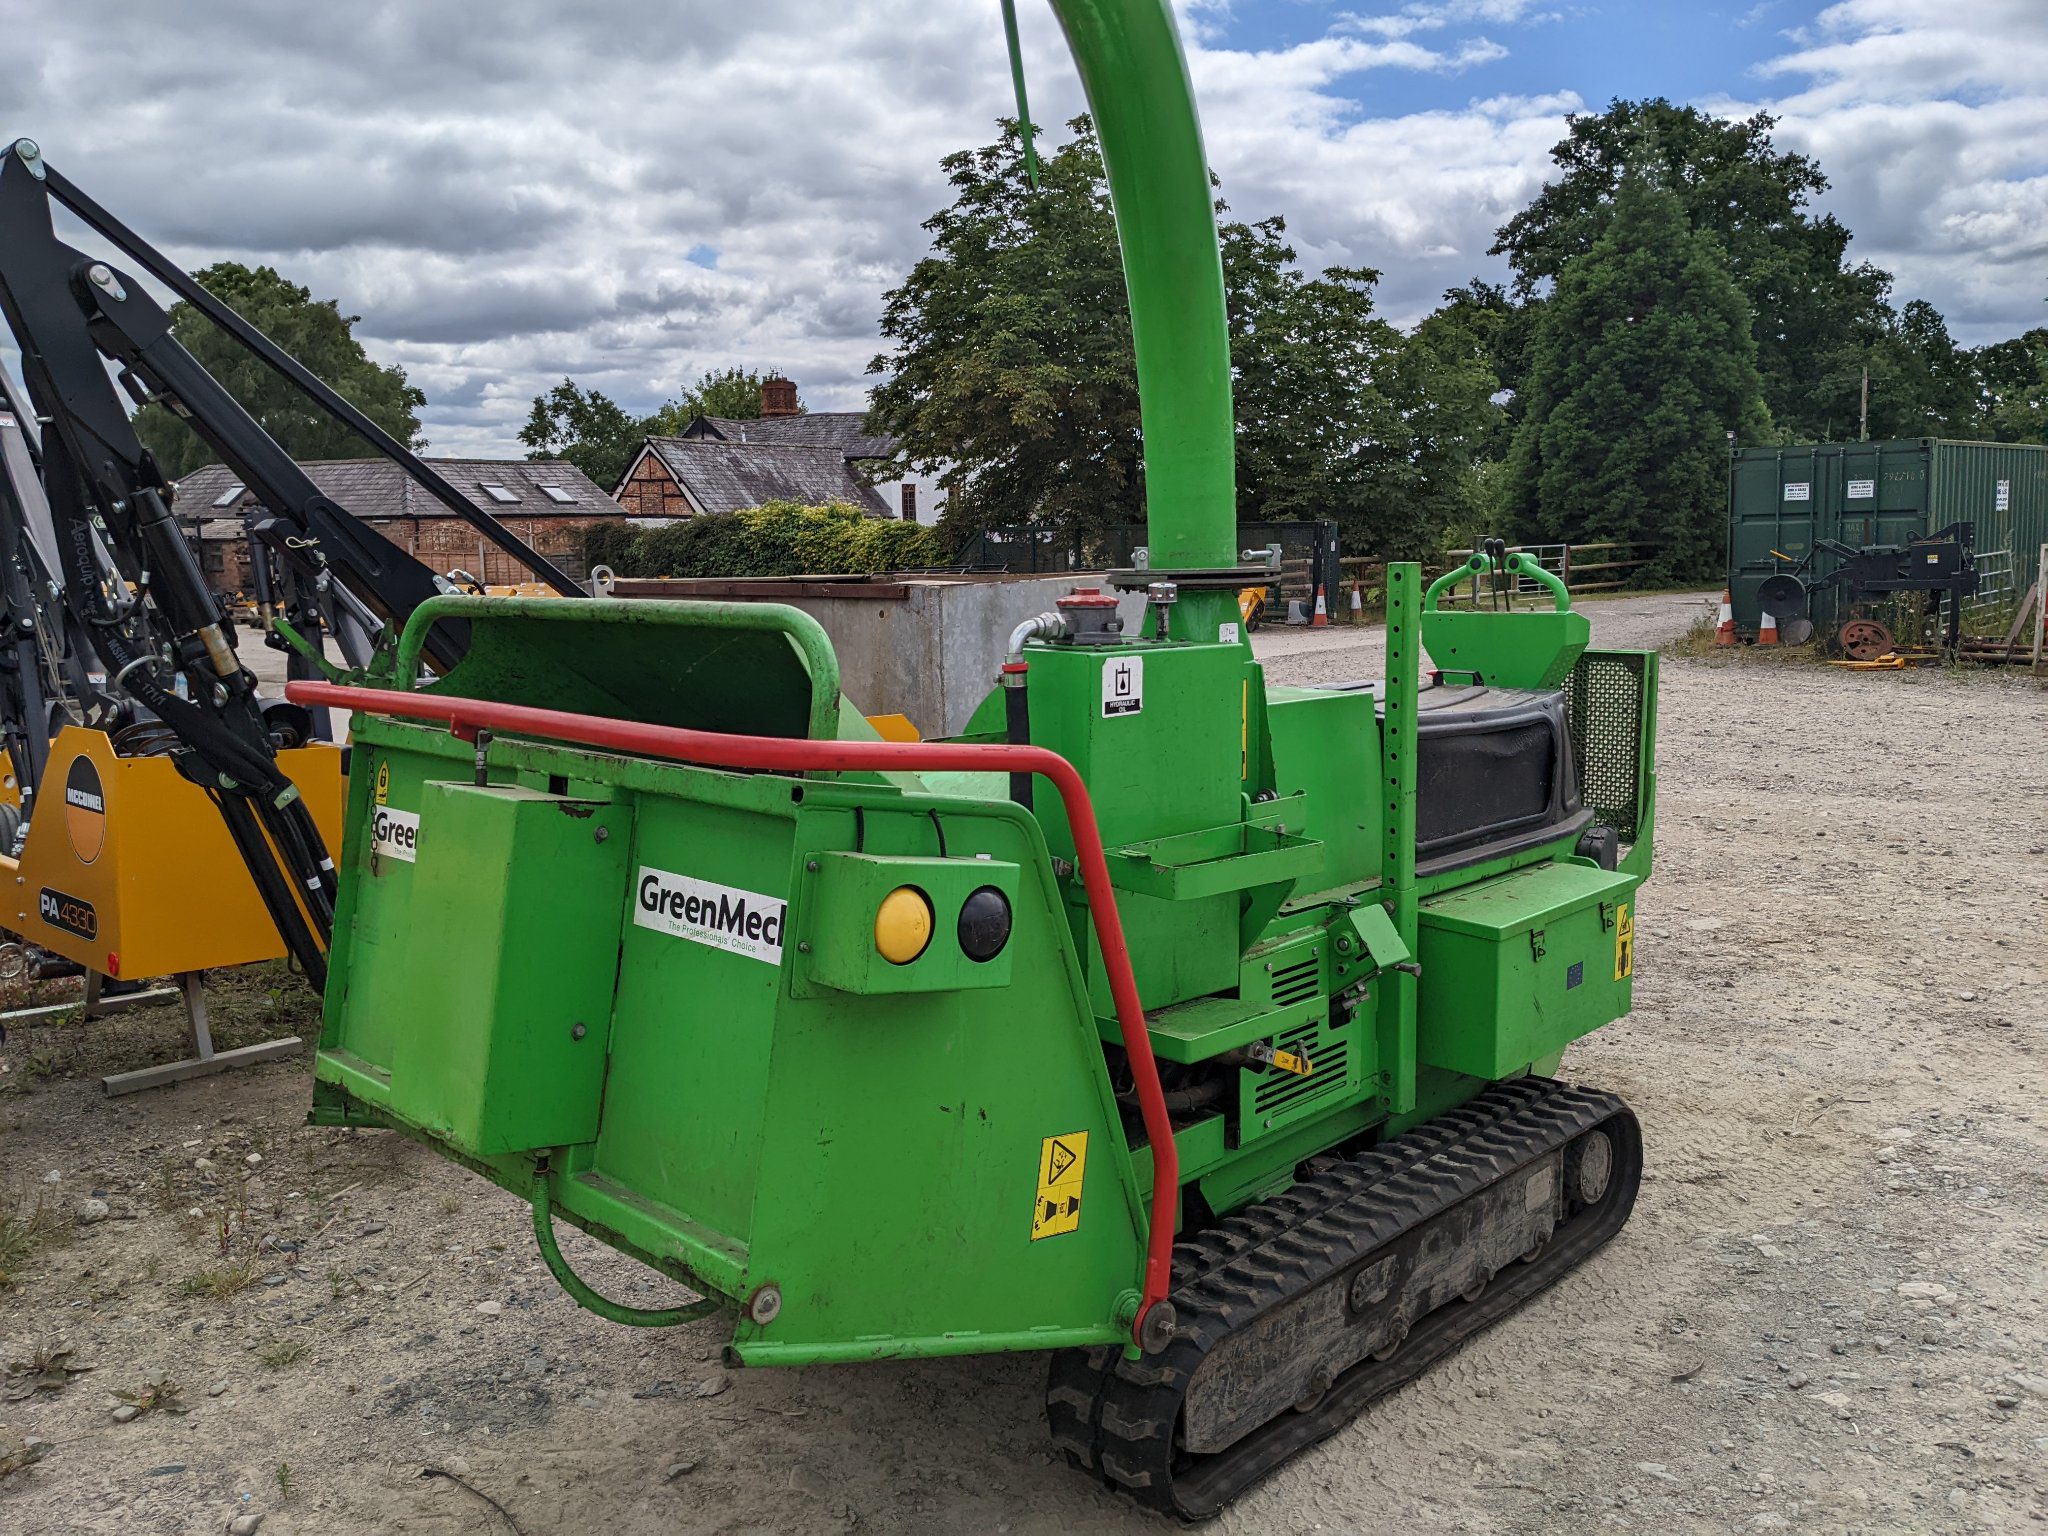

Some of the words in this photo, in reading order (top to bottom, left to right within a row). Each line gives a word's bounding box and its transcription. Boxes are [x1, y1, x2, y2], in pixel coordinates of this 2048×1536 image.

[68, 517, 96, 586] Aeroquip
[1110, 699, 1136, 707] HYDRAULIC
[40, 893, 60, 920] PA
[61, 902, 97, 934] 4330
[668, 920, 681, 932] The
[731, 937, 757, 953] Choice
